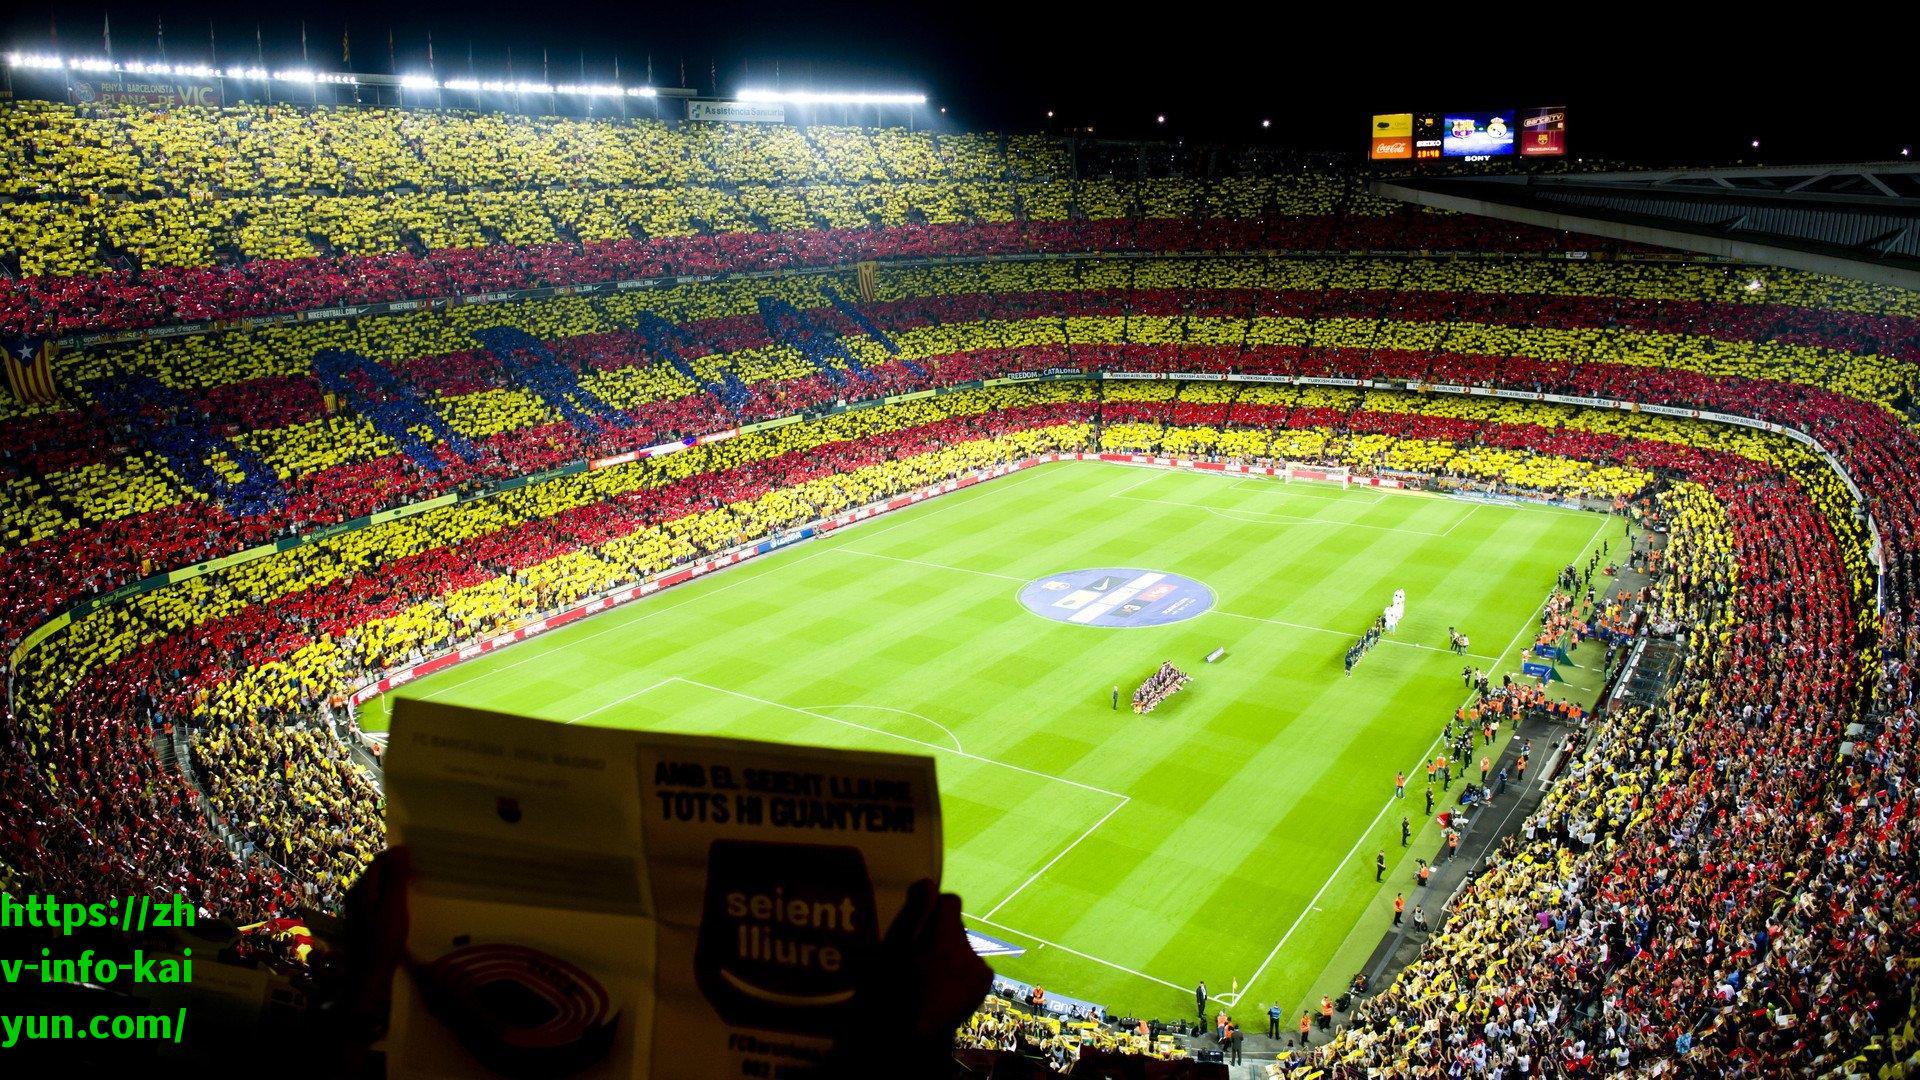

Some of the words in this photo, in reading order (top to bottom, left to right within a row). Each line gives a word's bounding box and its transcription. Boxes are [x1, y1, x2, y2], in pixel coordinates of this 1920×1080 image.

[101, 82, 123, 92] PENYA
[102, 94, 148, 104] PLANA
[158, 95, 175, 105] DE
[177, 85, 214, 106] VIC
[308, 307, 357, 320] NIKEFOOTBALL.COM
[148, 326, 176, 337] Botigues
[1007, 371, 1038, 380] FREEDOM
[1043, 368, 1080, 376] CATALONIA
[1558, 396, 1583, 404] TURKISH
[1661, 406, 1689, 416] AIRLINES
[1714, 414, 1739, 423] TURKISH
[1739, 417, 1763, 428] AIRLINES
[655, 762, 706, 788] AMB
[711, 765, 738, 790] EL
[743, 768, 823, 797] SEIENT
[656, 790, 731, 823] TOTS
[736, 795, 764, 825] HI
[726, 885, 857, 934] seient
[738, 922, 842, 973] lliure
